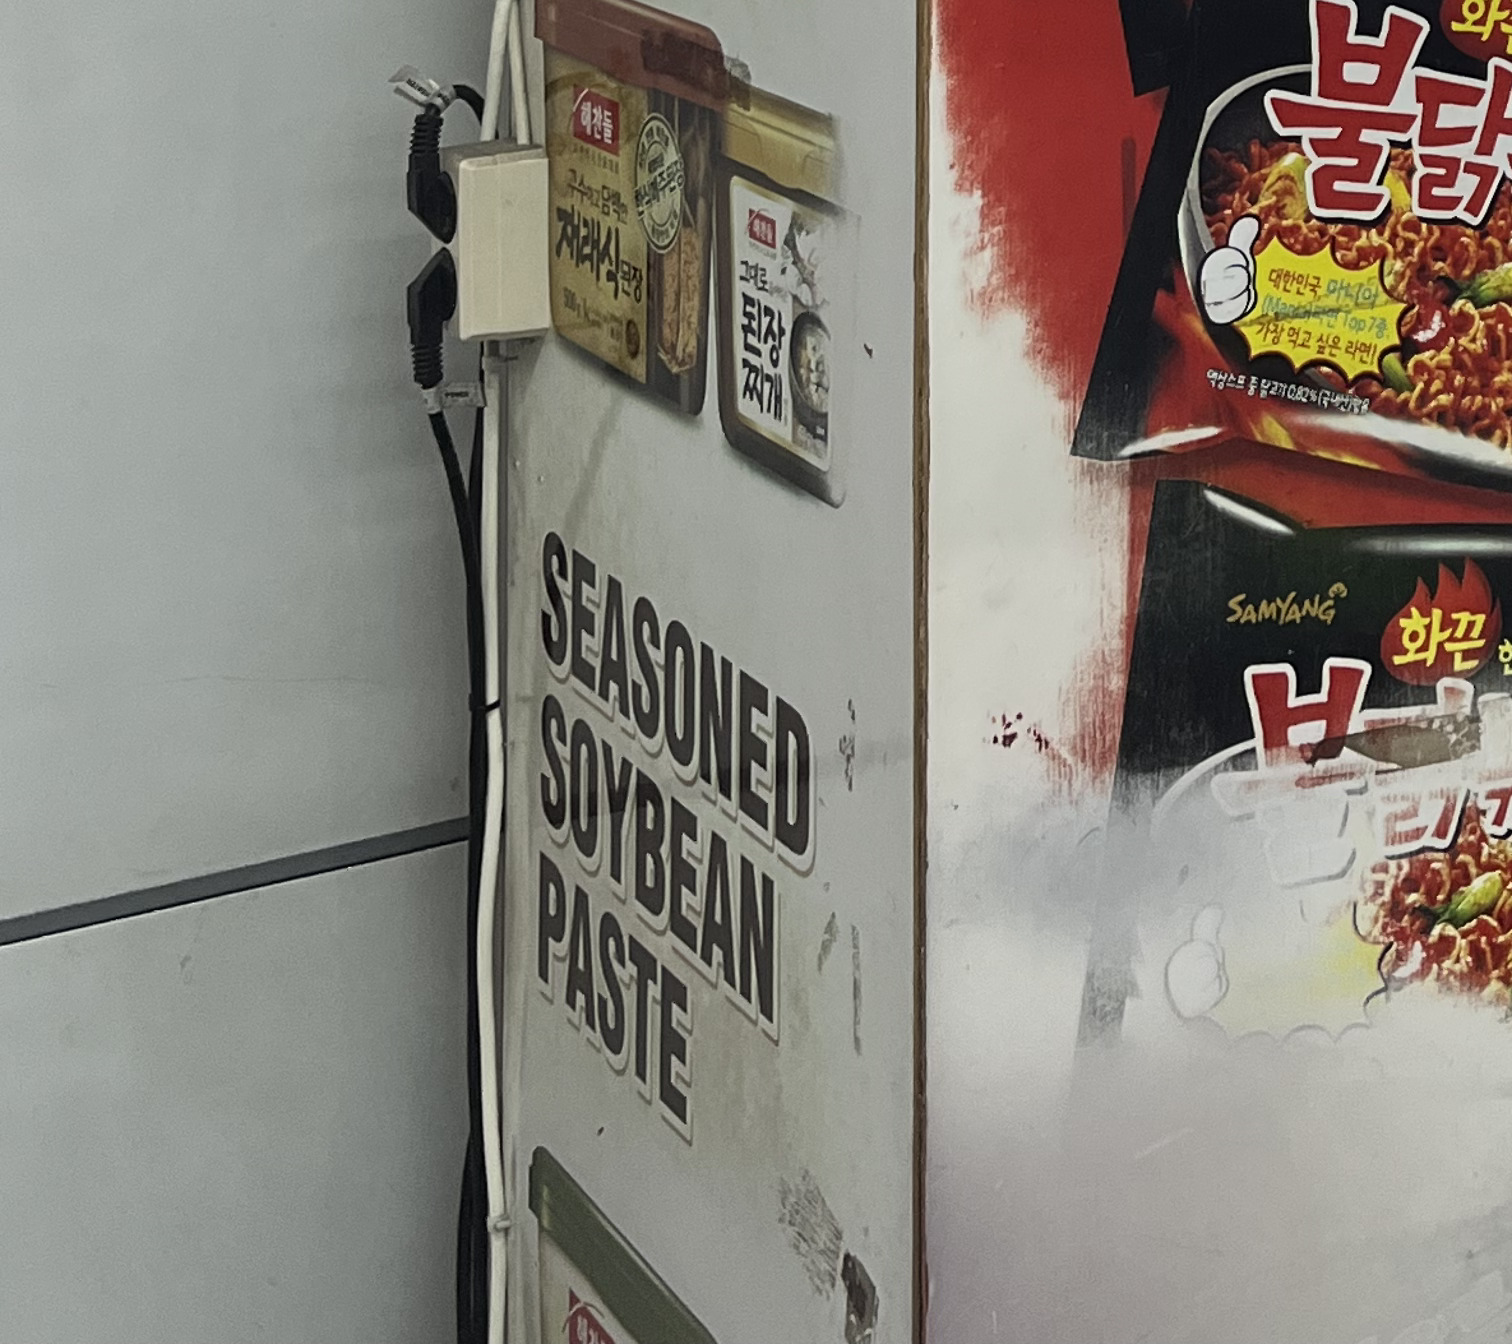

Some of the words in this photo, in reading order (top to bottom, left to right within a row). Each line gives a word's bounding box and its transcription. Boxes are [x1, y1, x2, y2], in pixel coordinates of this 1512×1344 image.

[581, 101, 613, 144] 해찬들
[556, 204, 620, 300] 재래식
[620, 259, 643, 304] 된장
[1268, 268, 1322, 298] 대한민국
[741, 291, 786, 369] 된장
[1256, 321, 1285, 345] 가장
[1287, 327, 1312, 349] 먹고
[1316, 333, 1341, 358] 싶은
[742, 358, 782, 422] 찌개
[1227, 594, 1337, 626] SAMYANG
[1393, 607, 1488, 673] 화끈
[541, 531, 811, 857] SEASONED
[540, 695, 775, 1026] SOYBEAN
[538, 851, 689, 1125] PASTE
